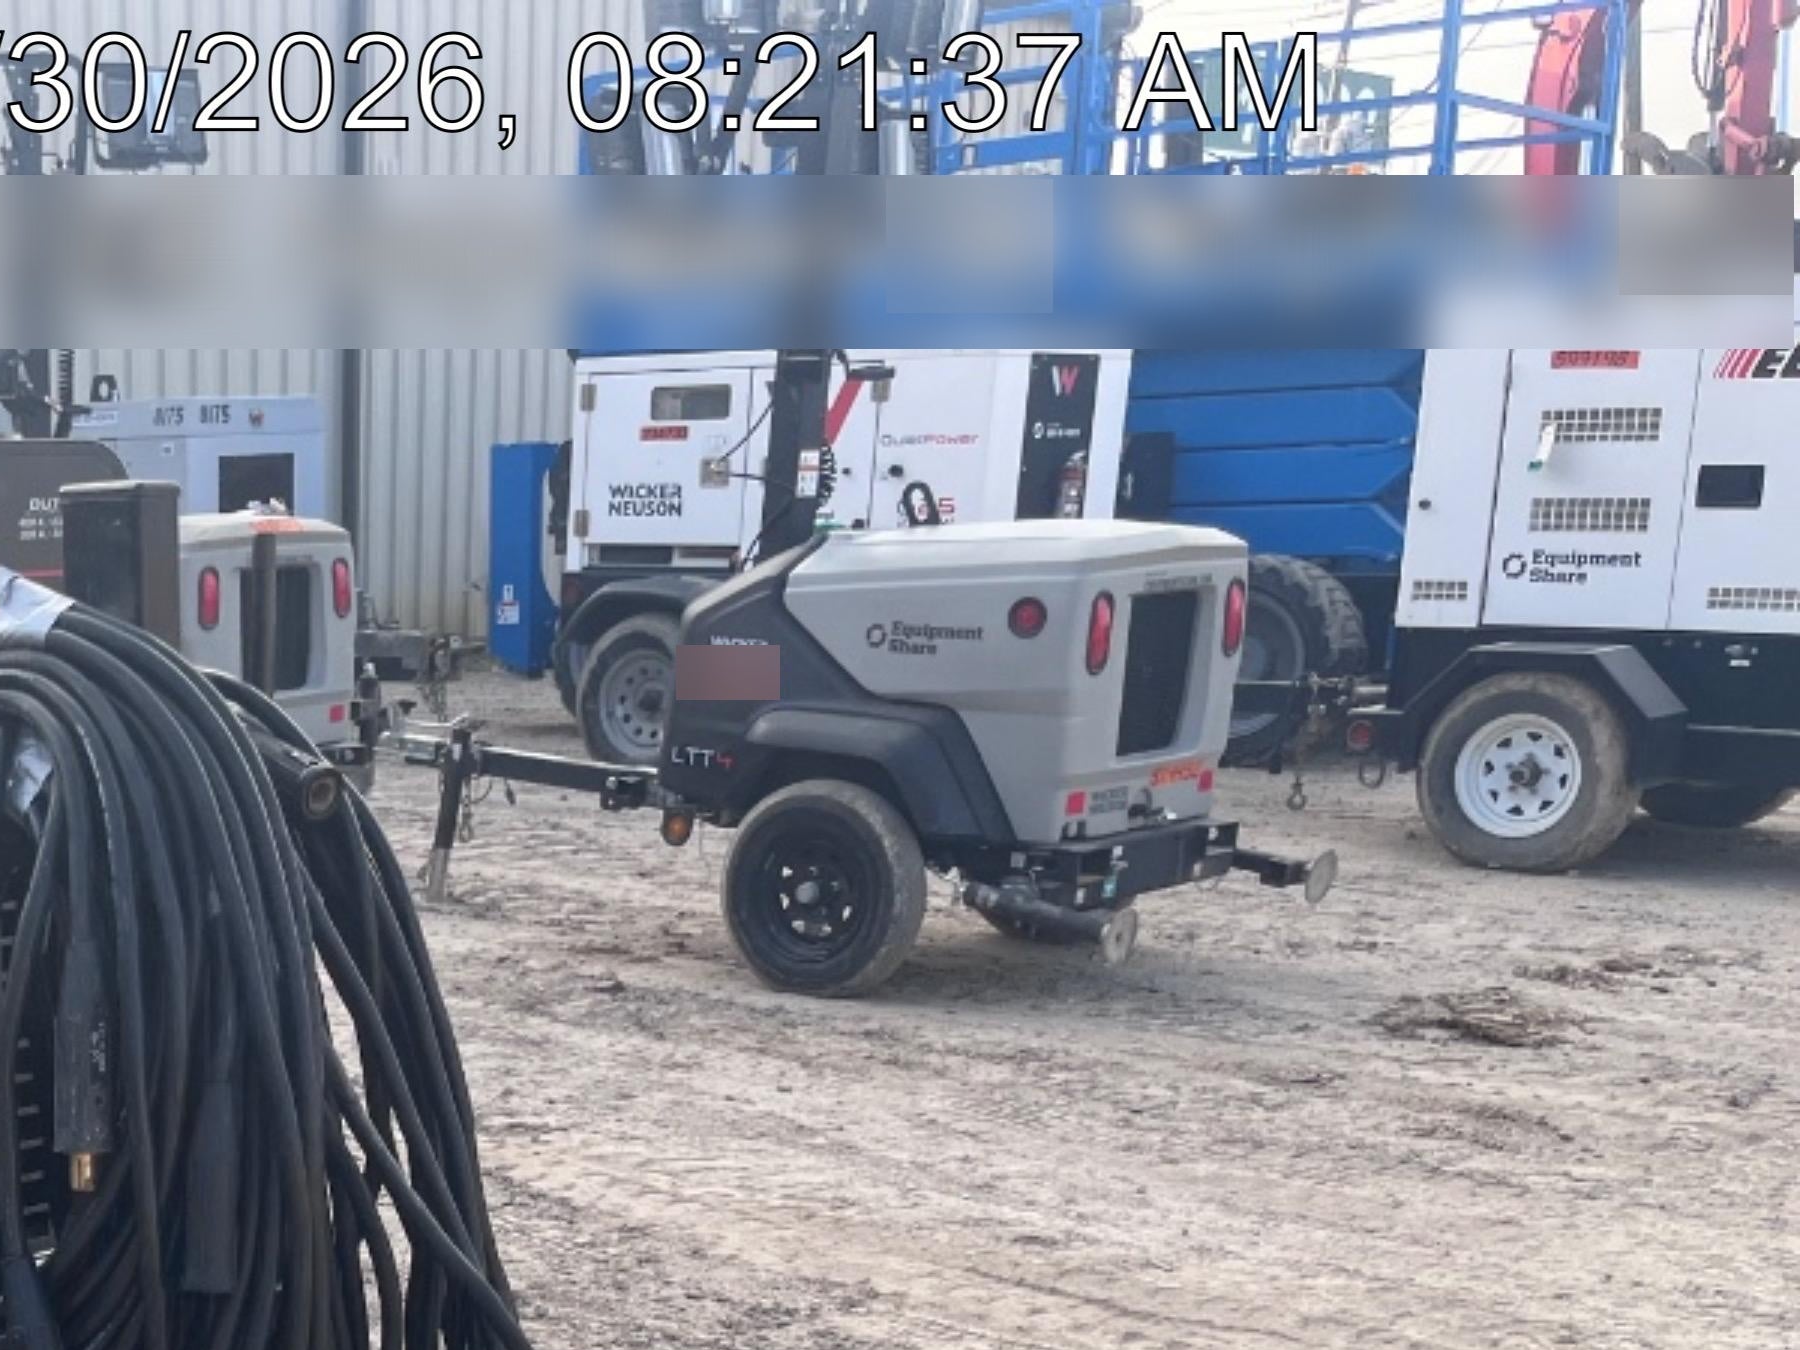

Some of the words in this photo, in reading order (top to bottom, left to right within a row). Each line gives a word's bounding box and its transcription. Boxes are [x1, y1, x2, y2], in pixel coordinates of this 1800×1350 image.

[609, 501, 682, 517] NEUSON
[1532, 549, 1642, 568] Equipment
[1529, 567, 1588, 584] Share
[890, 621, 984, 643] Equipment
